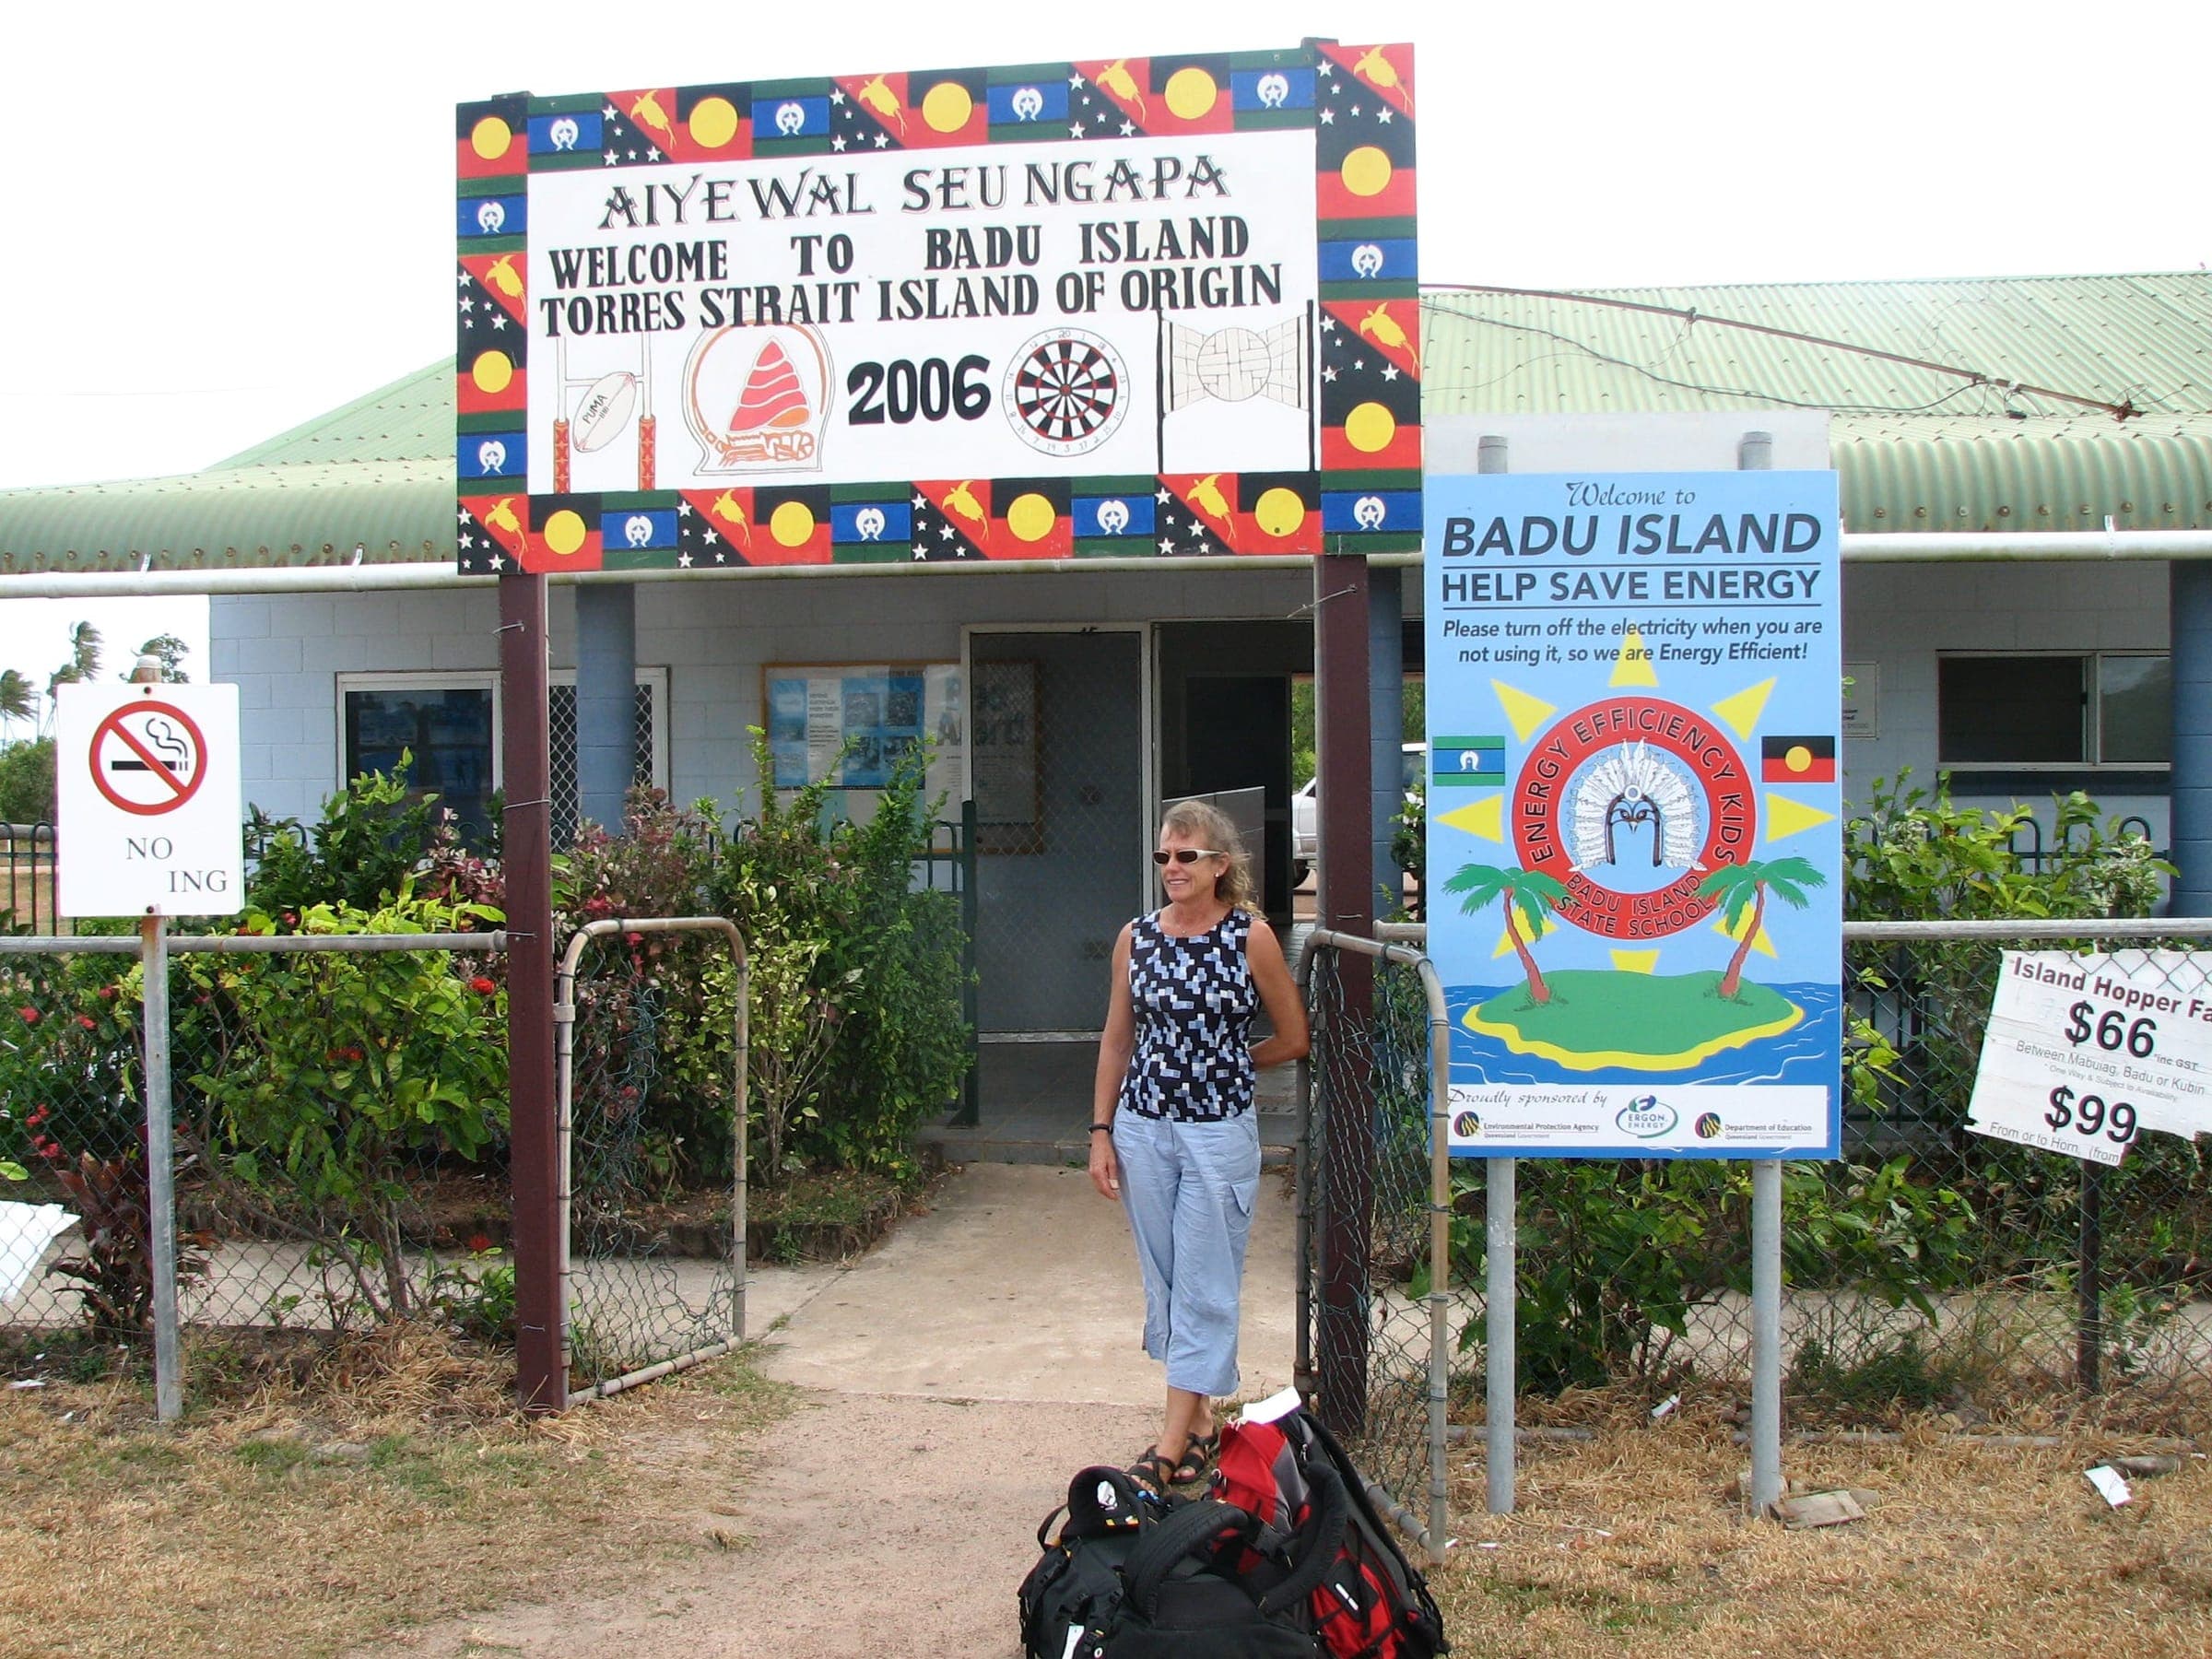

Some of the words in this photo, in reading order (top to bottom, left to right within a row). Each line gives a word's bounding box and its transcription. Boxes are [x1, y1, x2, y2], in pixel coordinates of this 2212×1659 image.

[598, 167, 876, 229] AIYEWAL
[901, 165, 1009, 214] SEU
[1023, 154, 1230, 207] NGAPA
[548, 239, 728, 289] WELCOME
[791, 233, 853, 276] TO
[924, 224, 1042, 270] BADU
[1078, 215, 1249, 264] ISLAND
[540, 289, 686, 337] TORRES
[700, 280, 859, 329] STRAIT
[877, 274, 1039, 322] ISLAND
[1055, 271, 1105, 314] OF
[1121, 263, 1282, 310] ORIGIN
[582, 394, 608, 425] PUMA
[847, 354, 991, 425] 2006
[1566, 481, 1666, 507] Welcome
[1676, 488, 1696, 505] to
[1442, 515, 1599, 557] BADU
[1618, 513, 1821, 555] ISLAND
[1442, 572, 1536, 602] HELP
[1550, 571, 1649, 601] SAVE
[1664, 570, 1821, 599] ENERGY
[1443, 619, 1500, 637] Please
[1505, 621, 1541, 636] turn
[1547, 618, 1572, 636] off
[1575, 618, 1605, 636] the
[1611, 618, 1697, 640] electricity
[1703, 618, 1750, 635] when
[1757, 621, 1790, 640] you
[1794, 621, 1822, 634] are
[1459, 647, 1489, 662] not
[1494, 647, 1540, 665] using
[1545, 645, 1562, 664] it,
[1568, 650, 1588, 662] so
[1593, 649, 1620, 661] we
[1625, 649, 1653, 661] are
[1659, 645, 1723, 665] Energy
[1728, 643, 1807, 661] Efficient!
[1524, 738, 1571, 864] ENERGY
[1572, 708, 1735, 781] EFFICIENCY
[1714, 793, 1743, 864] KIDS
[125, 837, 173, 860] NO
[169, 870, 228, 893] ING
[1566, 874, 1622, 912] BADU
[1631, 875, 1702, 916] ISLAND
[1557, 895, 1618, 934] STATE
[1628, 897, 1714, 936] SCHOOL
[2013, 957, 2087, 992] Island
[2093, 976, 2183, 1013] Hopper
[2064, 1000, 2157, 1058] $66
[2016, 1041, 2065, 1063] Between
[2067, 1052, 2120, 1077] Mabuiag,
[2124, 1065, 2154, 1084] Badu
[2156, 1075, 2169, 1087] or
[2171, 1077, 2206, 1095] Kubin
[2175, 1059, 2199, 1072] GST
[1448, 1088, 1512, 1108] Proudly
[1517, 1090, 1587, 1108] sponsored
[1593, 1090, 1608, 1108] by
[1628, 1113, 1665, 1122] ERGON
[2043, 1084, 2137, 1144] $99
[1483, 1123, 1535, 1131] Environmental
[1535, 1123, 1571, 1131] Protection
[1572, 1124, 1599, 1132] Agency
[1724, 1124, 1767, 1132] Department
[1777, 1124, 1813, 1132] Education
[1989, 1122, 2019, 1139] From
[2021, 1131, 2034, 1142] or
[2036, 1134, 2048, 1147] to
[2088, 1146, 2120, 1163] (from
